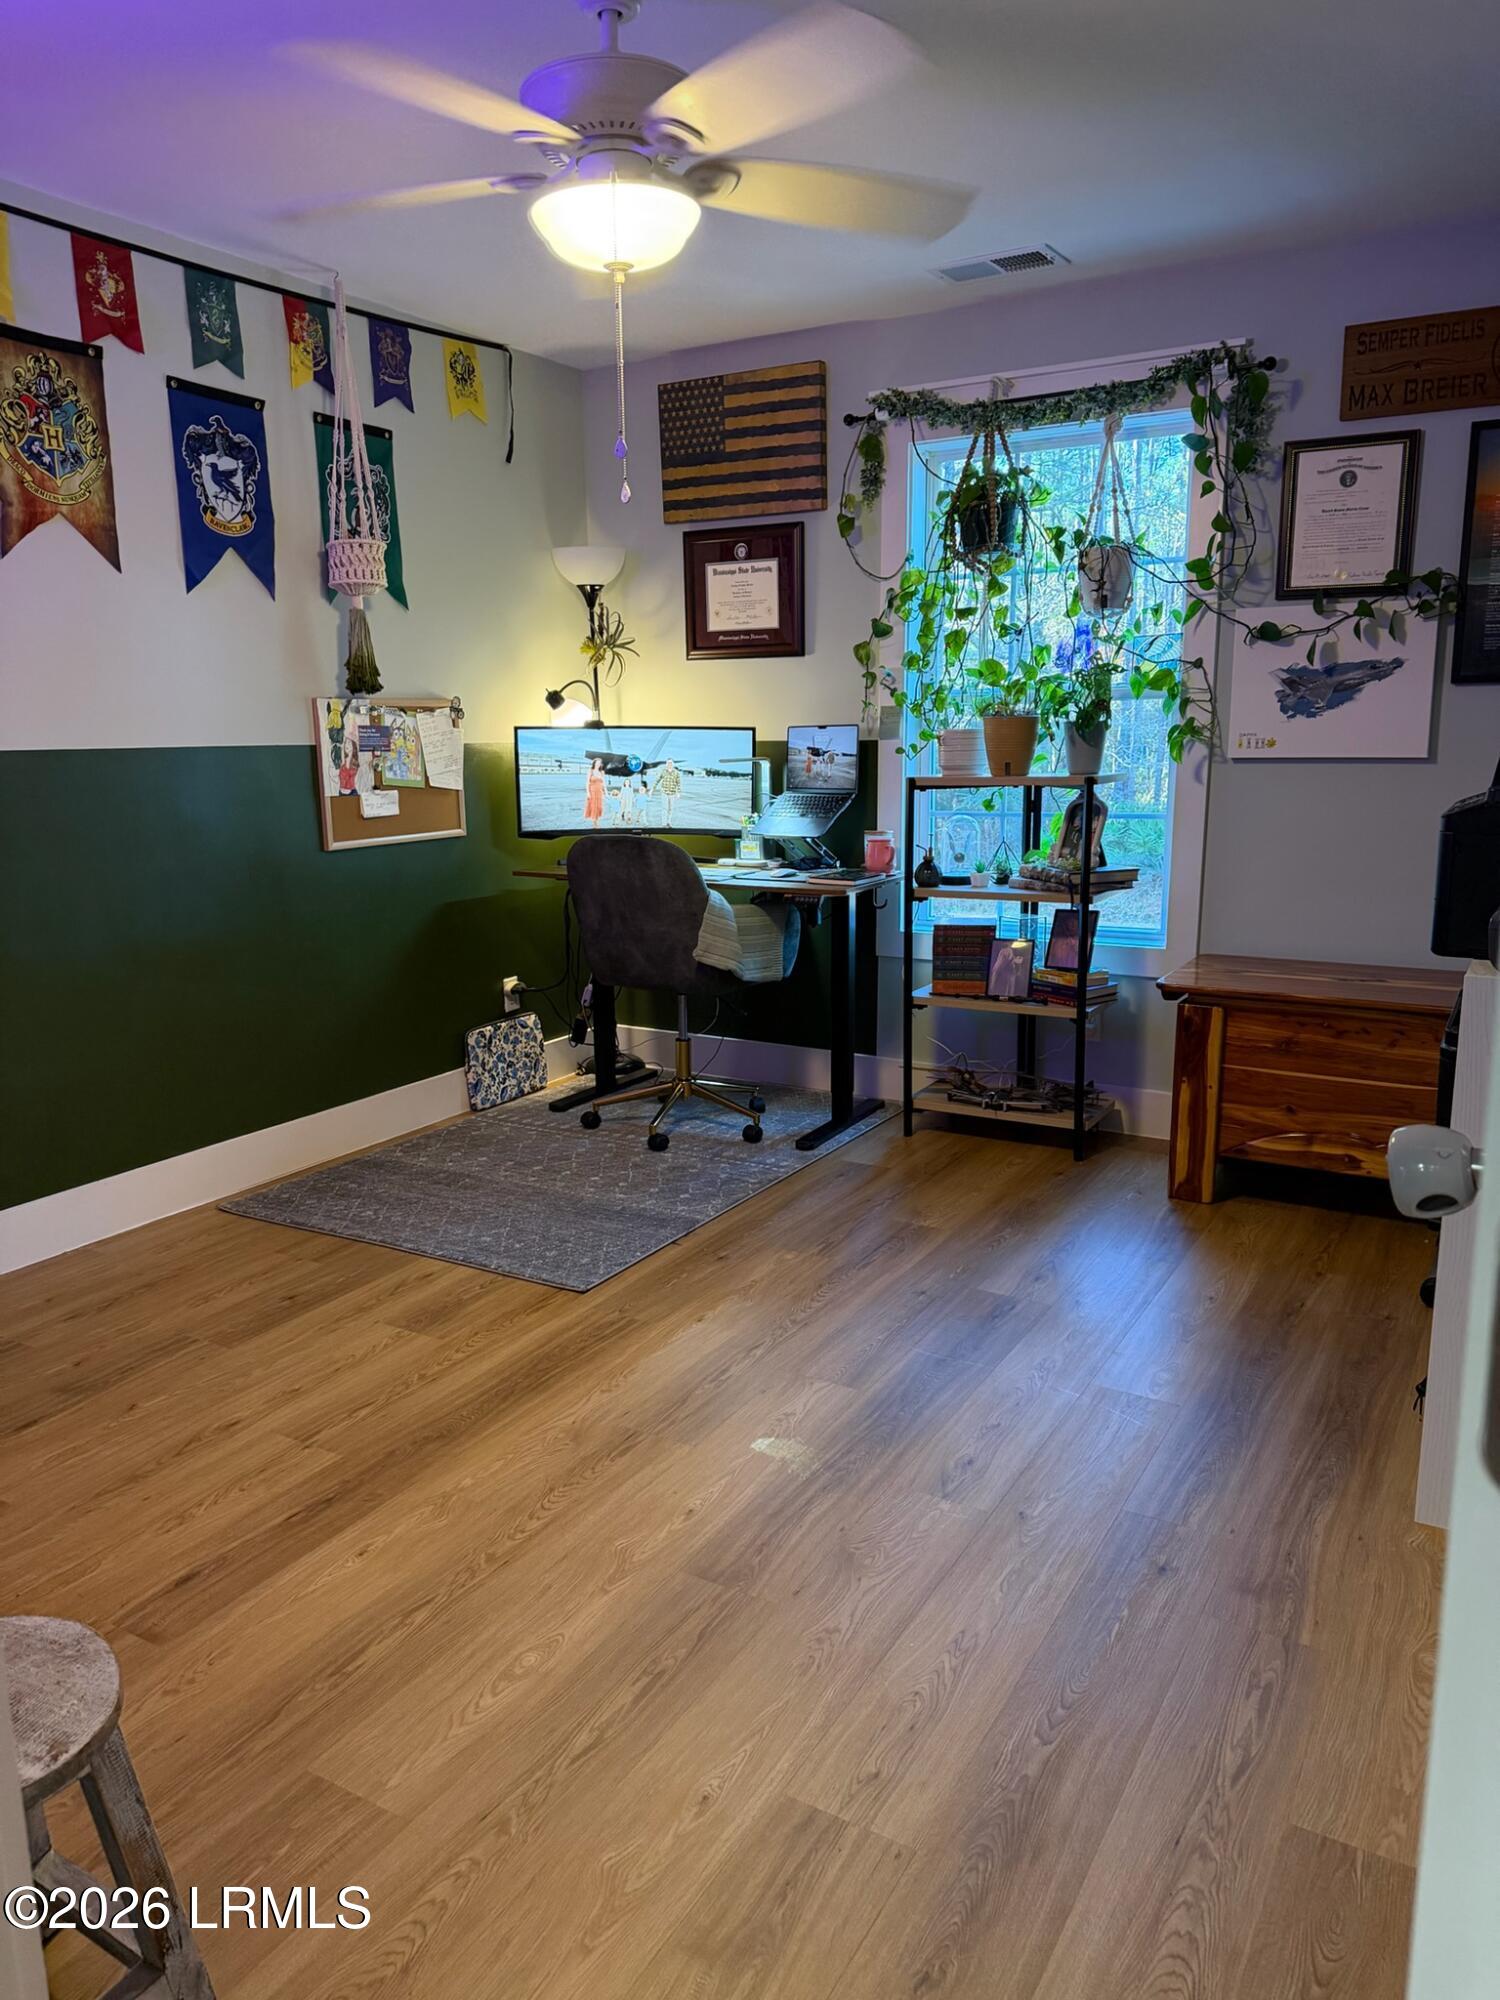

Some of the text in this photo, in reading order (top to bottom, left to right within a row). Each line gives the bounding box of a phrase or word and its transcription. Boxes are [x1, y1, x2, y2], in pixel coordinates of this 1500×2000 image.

[1356, 318, 1487, 355] SEMPER FIDELIS
[1348, 372, 1488, 411] MAX BREIER
[44, 427, 61, 448] H
[737, 566, 750, 575] State
[751, 565, 773, 574] University
